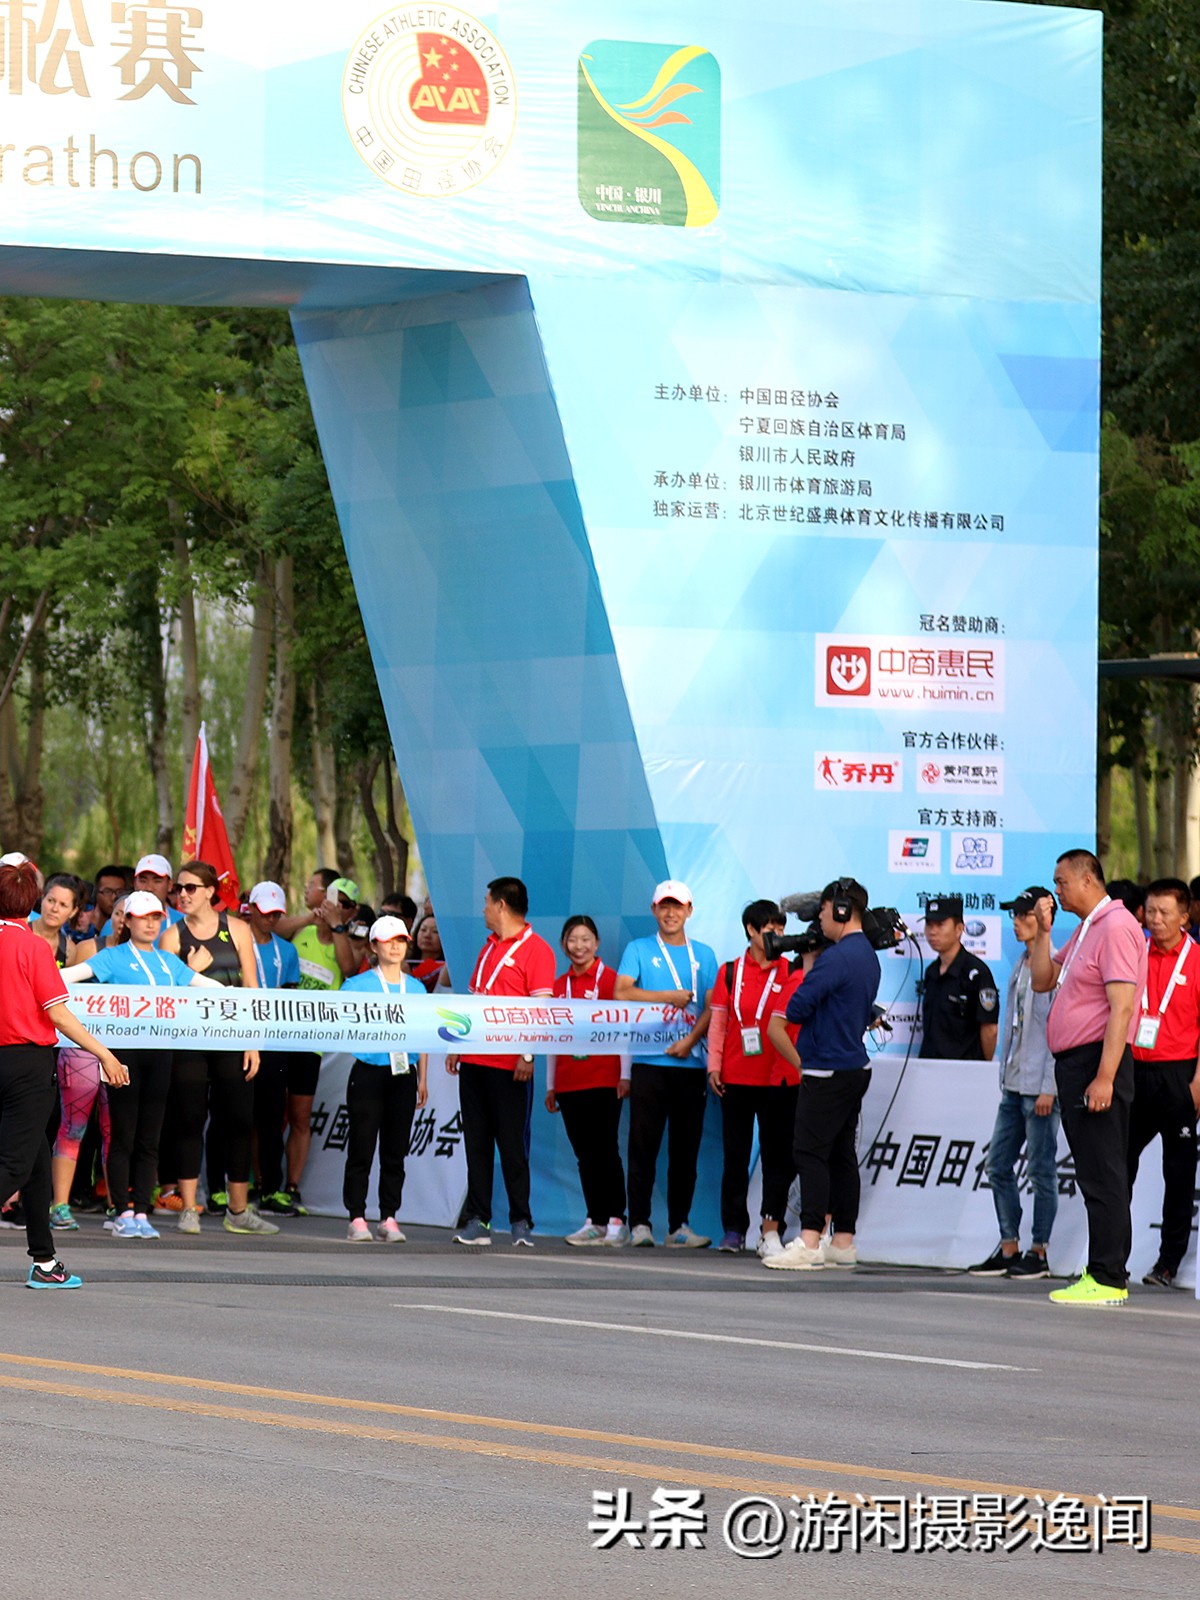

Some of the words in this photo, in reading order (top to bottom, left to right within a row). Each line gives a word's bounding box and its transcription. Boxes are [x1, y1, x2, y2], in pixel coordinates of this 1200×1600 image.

[349, 32, 385, 94] CHINESE
[383, 10, 447, 39] ATHLETIC
[450, 19, 510, 105] ASSOCIATION
[739, 416, 907, 442] 宁夏回族自治区体育局
[739, 445, 856, 469] 银川市人民政府
[877, 647, 995, 679] 中商惠民
[878, 685, 995, 702] www.huimin.cn
[841, 761, 895, 785] 乔丹
[196, 996, 407, 1026] 宁夏·银川国际马拉松
[483, 1006, 574, 1026] 中商惠民
[149, 1025, 198, 1041] Ningxia
[201, 1026, 260, 1041] Yinchuan
[263, 1027, 345, 1042] International
[347, 1028, 407, 1042] Marathon
[485, 1029, 574, 1044] www.huimin.cn
[590, 1031, 620, 1043] 2017
[653, 1031, 675, 1043] Silk
[310, 1102, 464, 1159] 中国协会
